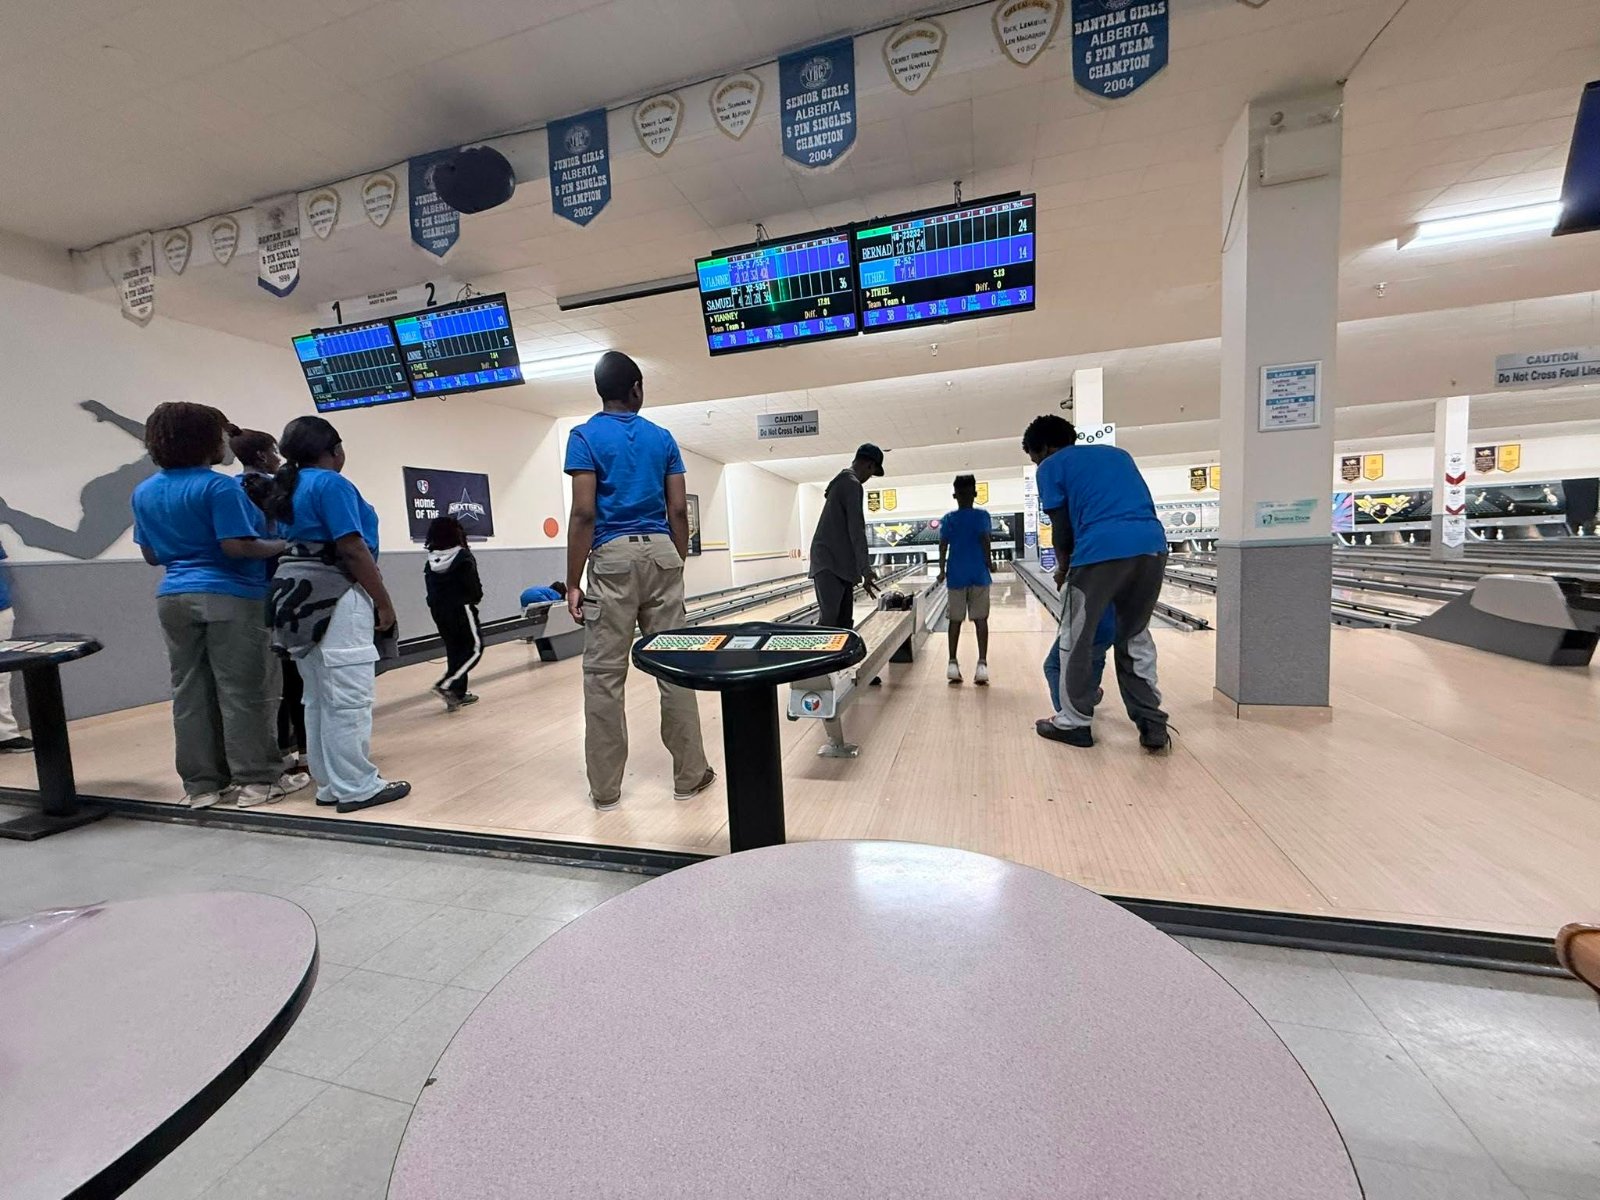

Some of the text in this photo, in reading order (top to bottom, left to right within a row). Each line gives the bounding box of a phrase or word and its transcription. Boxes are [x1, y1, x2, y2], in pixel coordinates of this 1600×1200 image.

[1074, 2, 1166, 35] BANTAM GIRLS
[1091, 22, 1149, 47] ALBERTA
[1085, 36, 1155, 65] 5 PIN TEAM
[1088, 54, 1150, 80] CHAMPION
[1104, 76, 1134, 94] 2004
[786, 83, 850, 110] SENIOR GIRLS
[795, 100, 841, 121] ALBERTA
[786, 111, 852, 138] 5 PIN SINGLES
[796, 129, 844, 151] CHAMPION
[554, 149, 605, 171] JUNIOR GIRLS
[808, 148, 833, 163] 2004
[561, 164, 598, 182] ALBERTA
[555, 174, 607, 197] 5 PIN SINGLES
[415, 192, 438, 206] JUNIOR
[563, 189, 601, 207] CHAMPION
[573, 206, 593, 218] 2002
[421, 217, 433, 228] PIN
[1018, 219, 1028, 232] 24
[422, 223, 456, 239] CHAMPION
[266, 240, 292, 252] ALBERTA
[862, 243, 892, 260] BERNAD
[1019, 246, 1028, 259] 14
[267, 254, 276, 264] PIN
[277, 248, 300, 260] SINGLES
[268, 260, 296, 274] CHAMPION
[332, 282, 437, 325] 1 2
[706, 296, 734, 311] SAMUEL
[883, 298, 900, 306] Team
[1019, 289, 1027, 302] 38
[725, 323, 740, 332] Team
[1526, 352, 1579, 365] CAUTION
[1498, 365, 1600, 383] Do Not Cross Foul Line
[775, 414, 803, 423] CAUTION
[768, 428, 777, 436] Not
[778, 427, 792, 435] Cross
[793, 426, 804, 434] Foul
[805, 425, 817, 433] Line
[414, 498, 435, 508] HOME
[415, 510, 440, 519] OF THE
